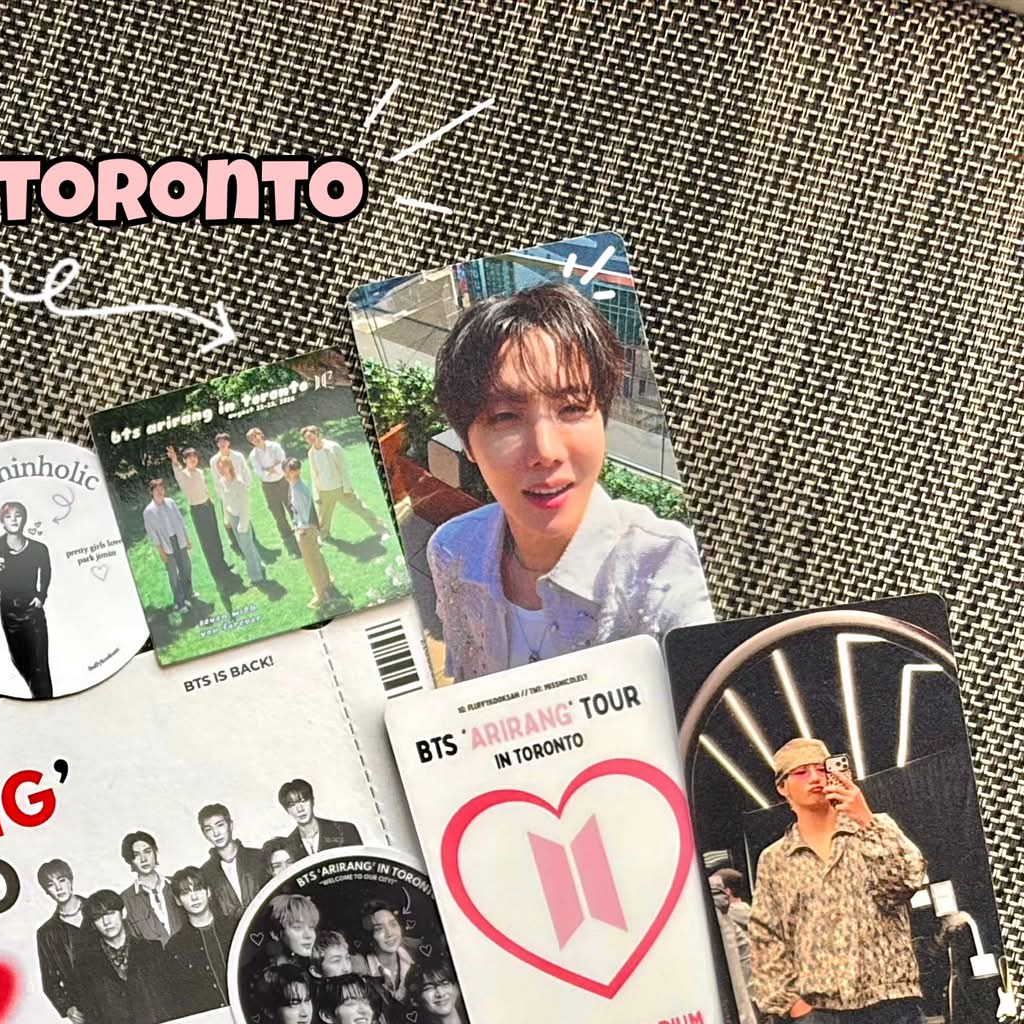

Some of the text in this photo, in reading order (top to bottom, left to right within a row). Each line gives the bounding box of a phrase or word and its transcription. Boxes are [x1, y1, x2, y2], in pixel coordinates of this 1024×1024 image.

[111, 380, 308, 444] bts arirang in toronto
[66, 547, 88, 559] pretty
[89, 541, 106, 553] girls
[78, 550, 116, 566] park jimin
[183, 655, 275, 692] BTS IS BACK!
[416, 733, 458, 764] BTS
[579, 684, 641, 719] TOUR
[494, 732, 584, 770] IN TORONTO
[296, 860, 434, 897] BTS 'ARIRANG' IN TORON
